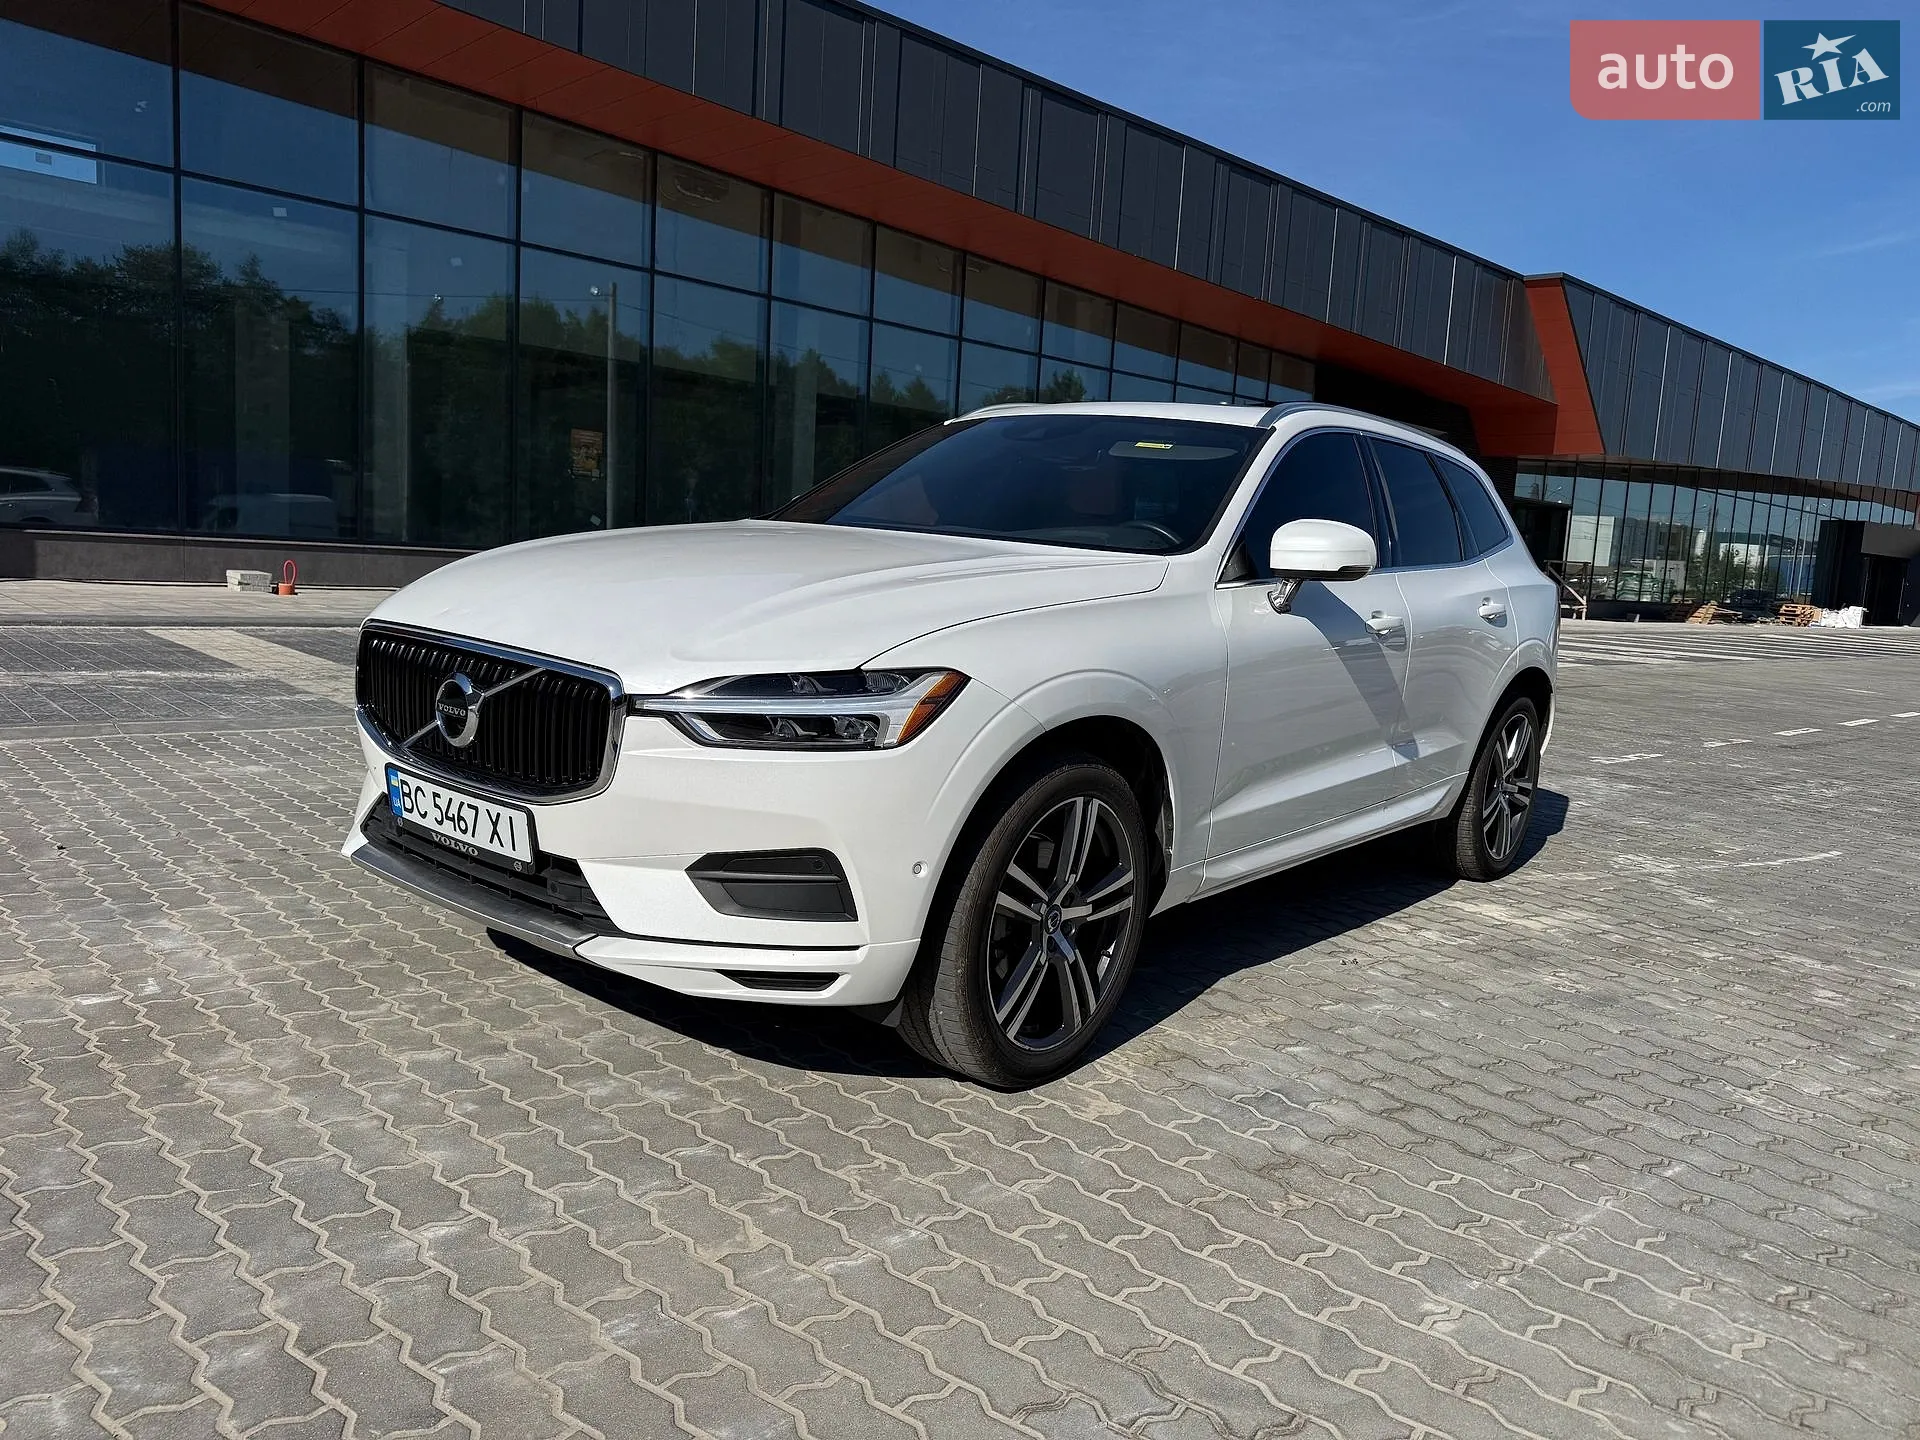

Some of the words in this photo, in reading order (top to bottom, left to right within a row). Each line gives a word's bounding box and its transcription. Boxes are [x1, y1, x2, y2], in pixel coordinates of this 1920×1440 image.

[438, 702, 466, 717] VOLVO
[400, 779, 428, 820] BC
[432, 791, 479, 838] 5467
[486, 808, 516, 852] XI
[431, 832, 479, 856] VOLVO
